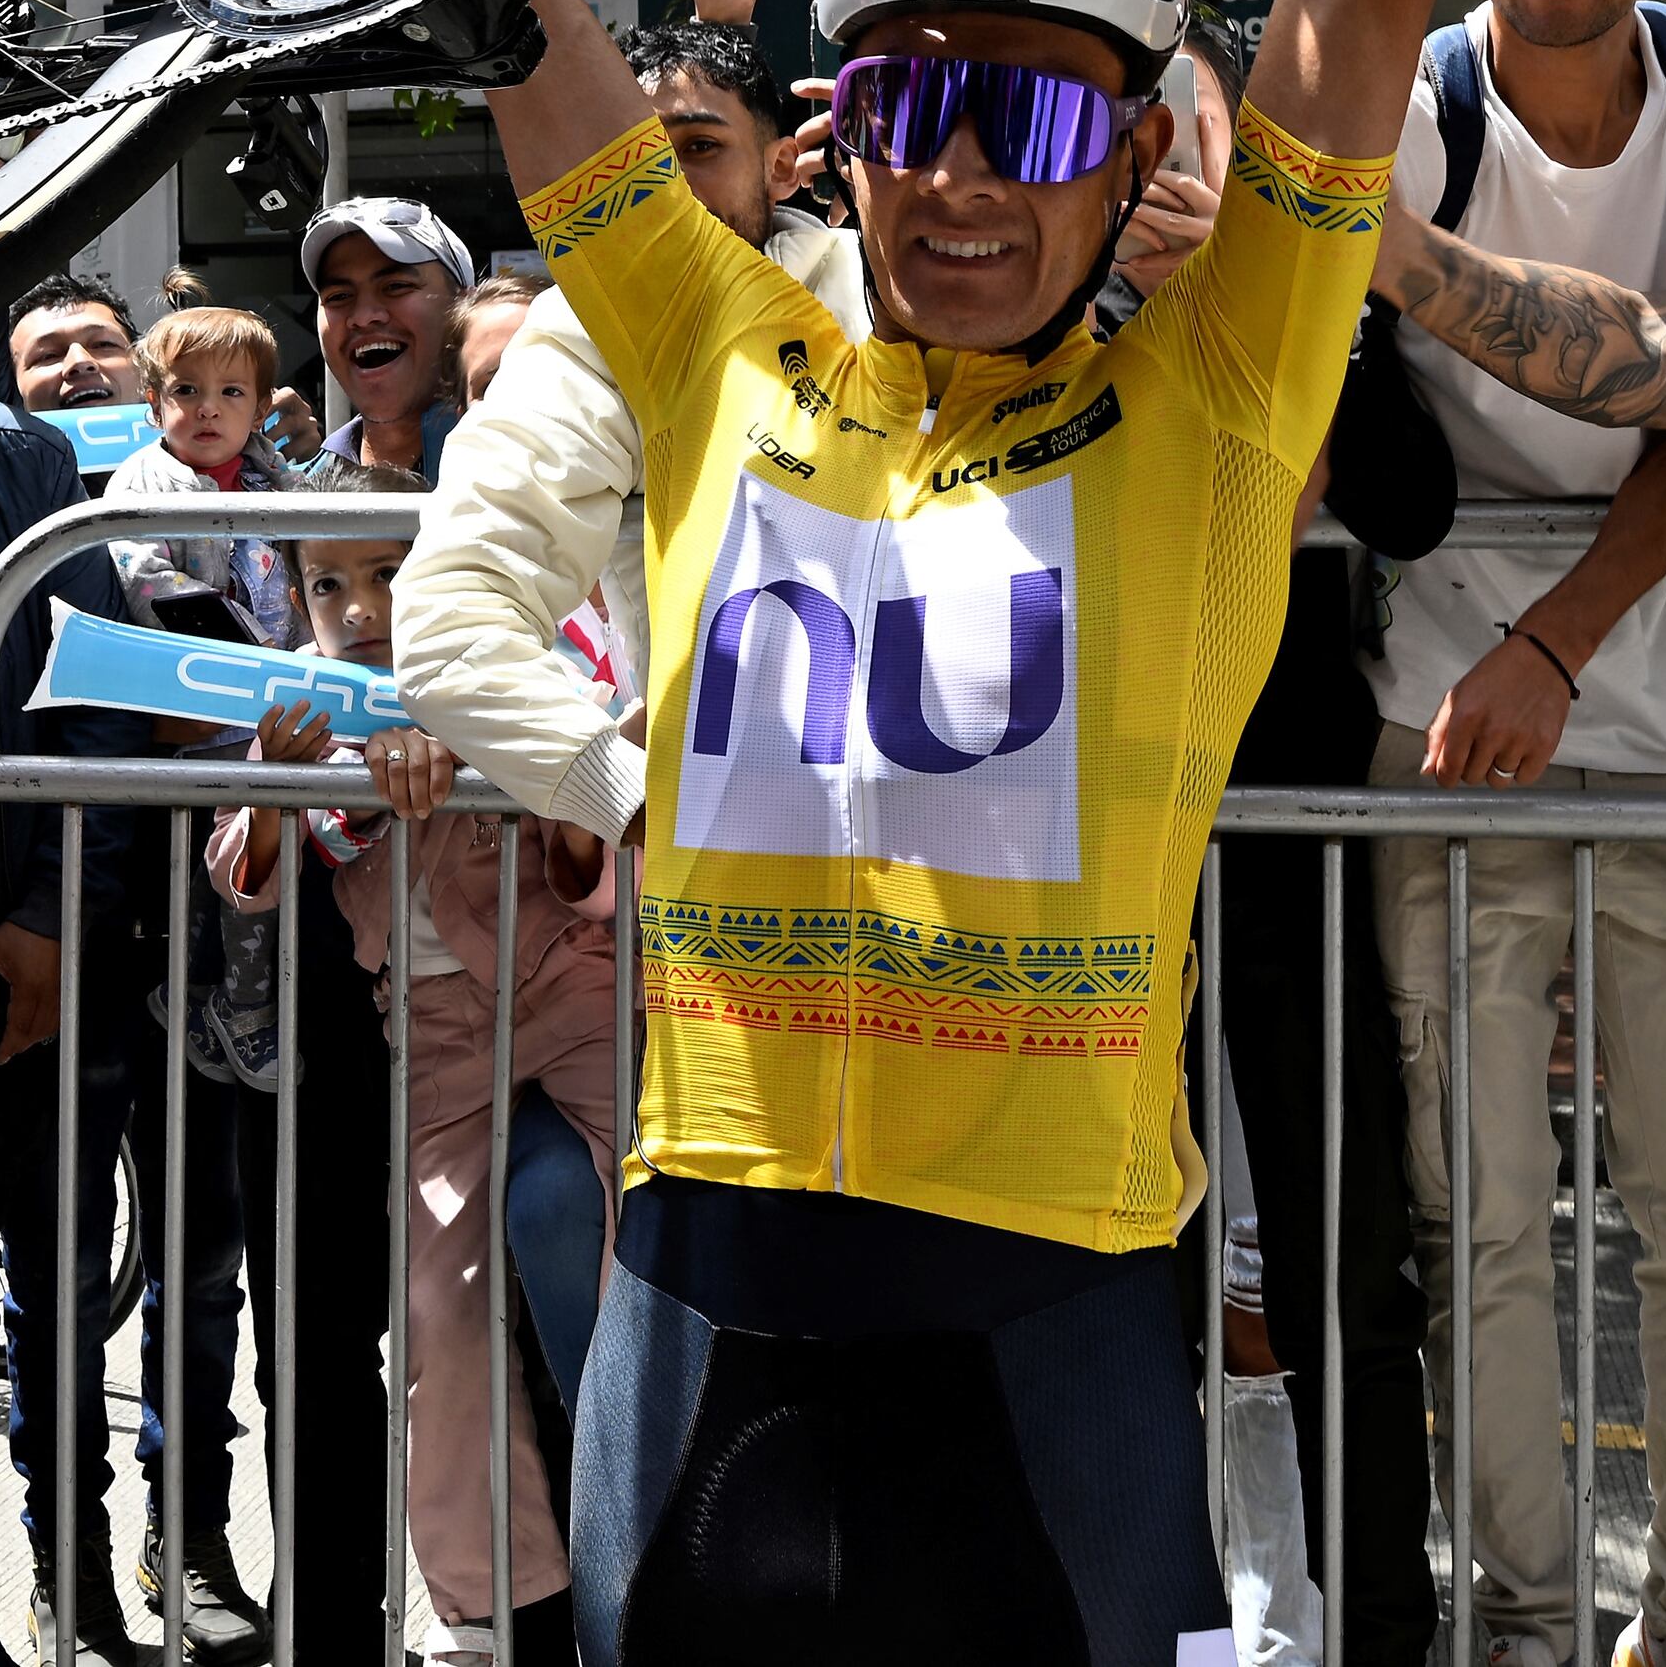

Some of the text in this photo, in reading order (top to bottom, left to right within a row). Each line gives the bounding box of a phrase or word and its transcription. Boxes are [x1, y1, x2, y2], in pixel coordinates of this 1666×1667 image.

[791, 378, 819, 419] VIDA
[1049, 398, 1111, 446] AMERICA
[1049, 430, 1090, 455] TOUR
[746, 422, 817, 482] LÍDER
[932, 455, 1000, 495] UCI
[693, 567, 1063, 775] nu
